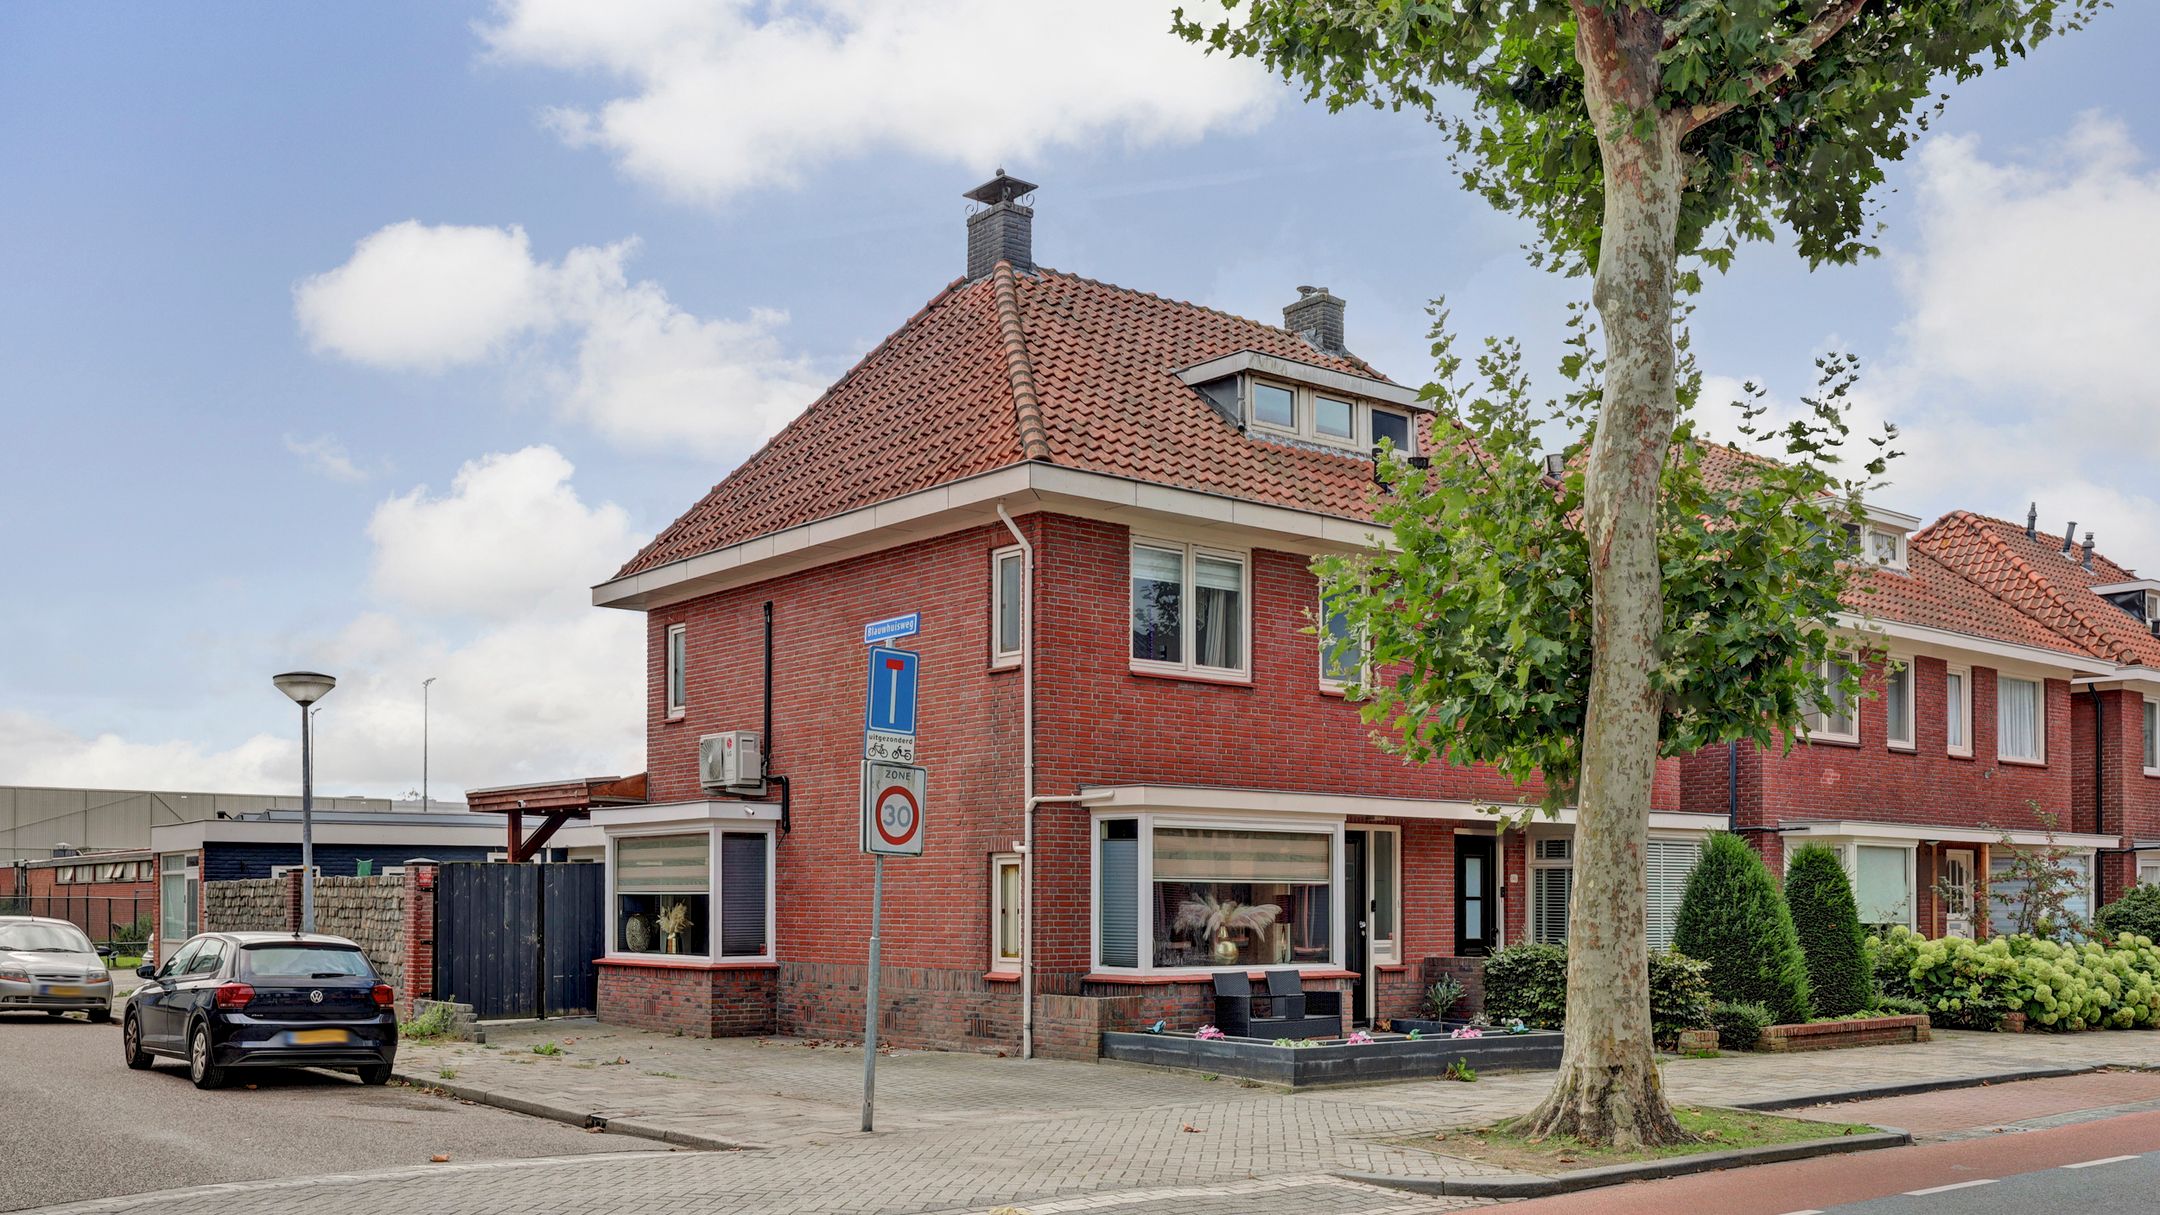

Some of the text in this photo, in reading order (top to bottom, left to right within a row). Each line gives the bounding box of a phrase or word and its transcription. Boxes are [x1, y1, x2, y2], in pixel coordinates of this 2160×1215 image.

[867, 620, 914, 637] Blauwhuisweg
[868, 733, 913, 745] uitgezonderd
[885, 770, 911, 780] ZONE
[883, 804, 911, 827] 30
